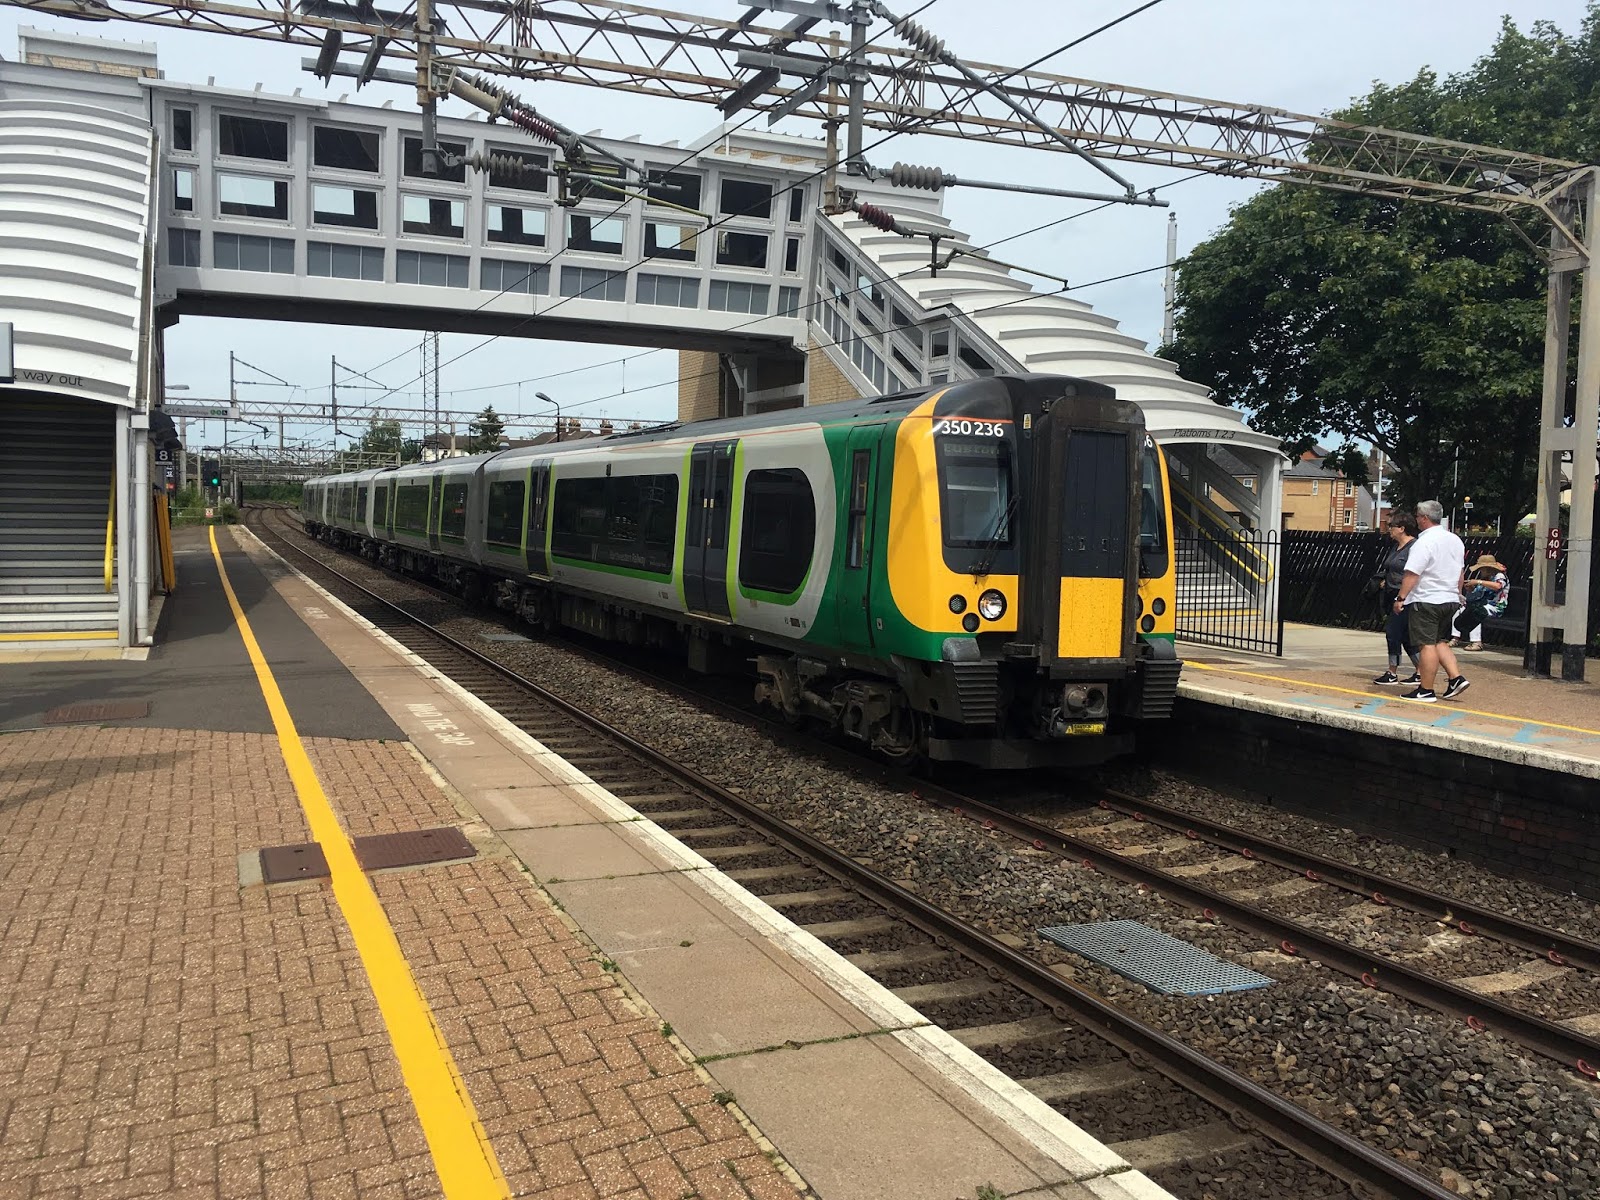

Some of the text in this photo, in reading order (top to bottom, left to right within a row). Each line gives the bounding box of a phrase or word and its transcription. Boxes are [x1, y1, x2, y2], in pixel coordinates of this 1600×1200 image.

[23, 371, 54, 384] way
[59, 375, 83, 387] out
[941, 420, 972, 435] 350
[973, 421, 1004, 438] 236
[1173, 429, 1211, 438] Platforms
[159, 450, 168, 461] 8
[1551, 529, 1559, 538] G
[1548, 539, 1560, 549] 40
[1548, 550, 1557, 559] 14
